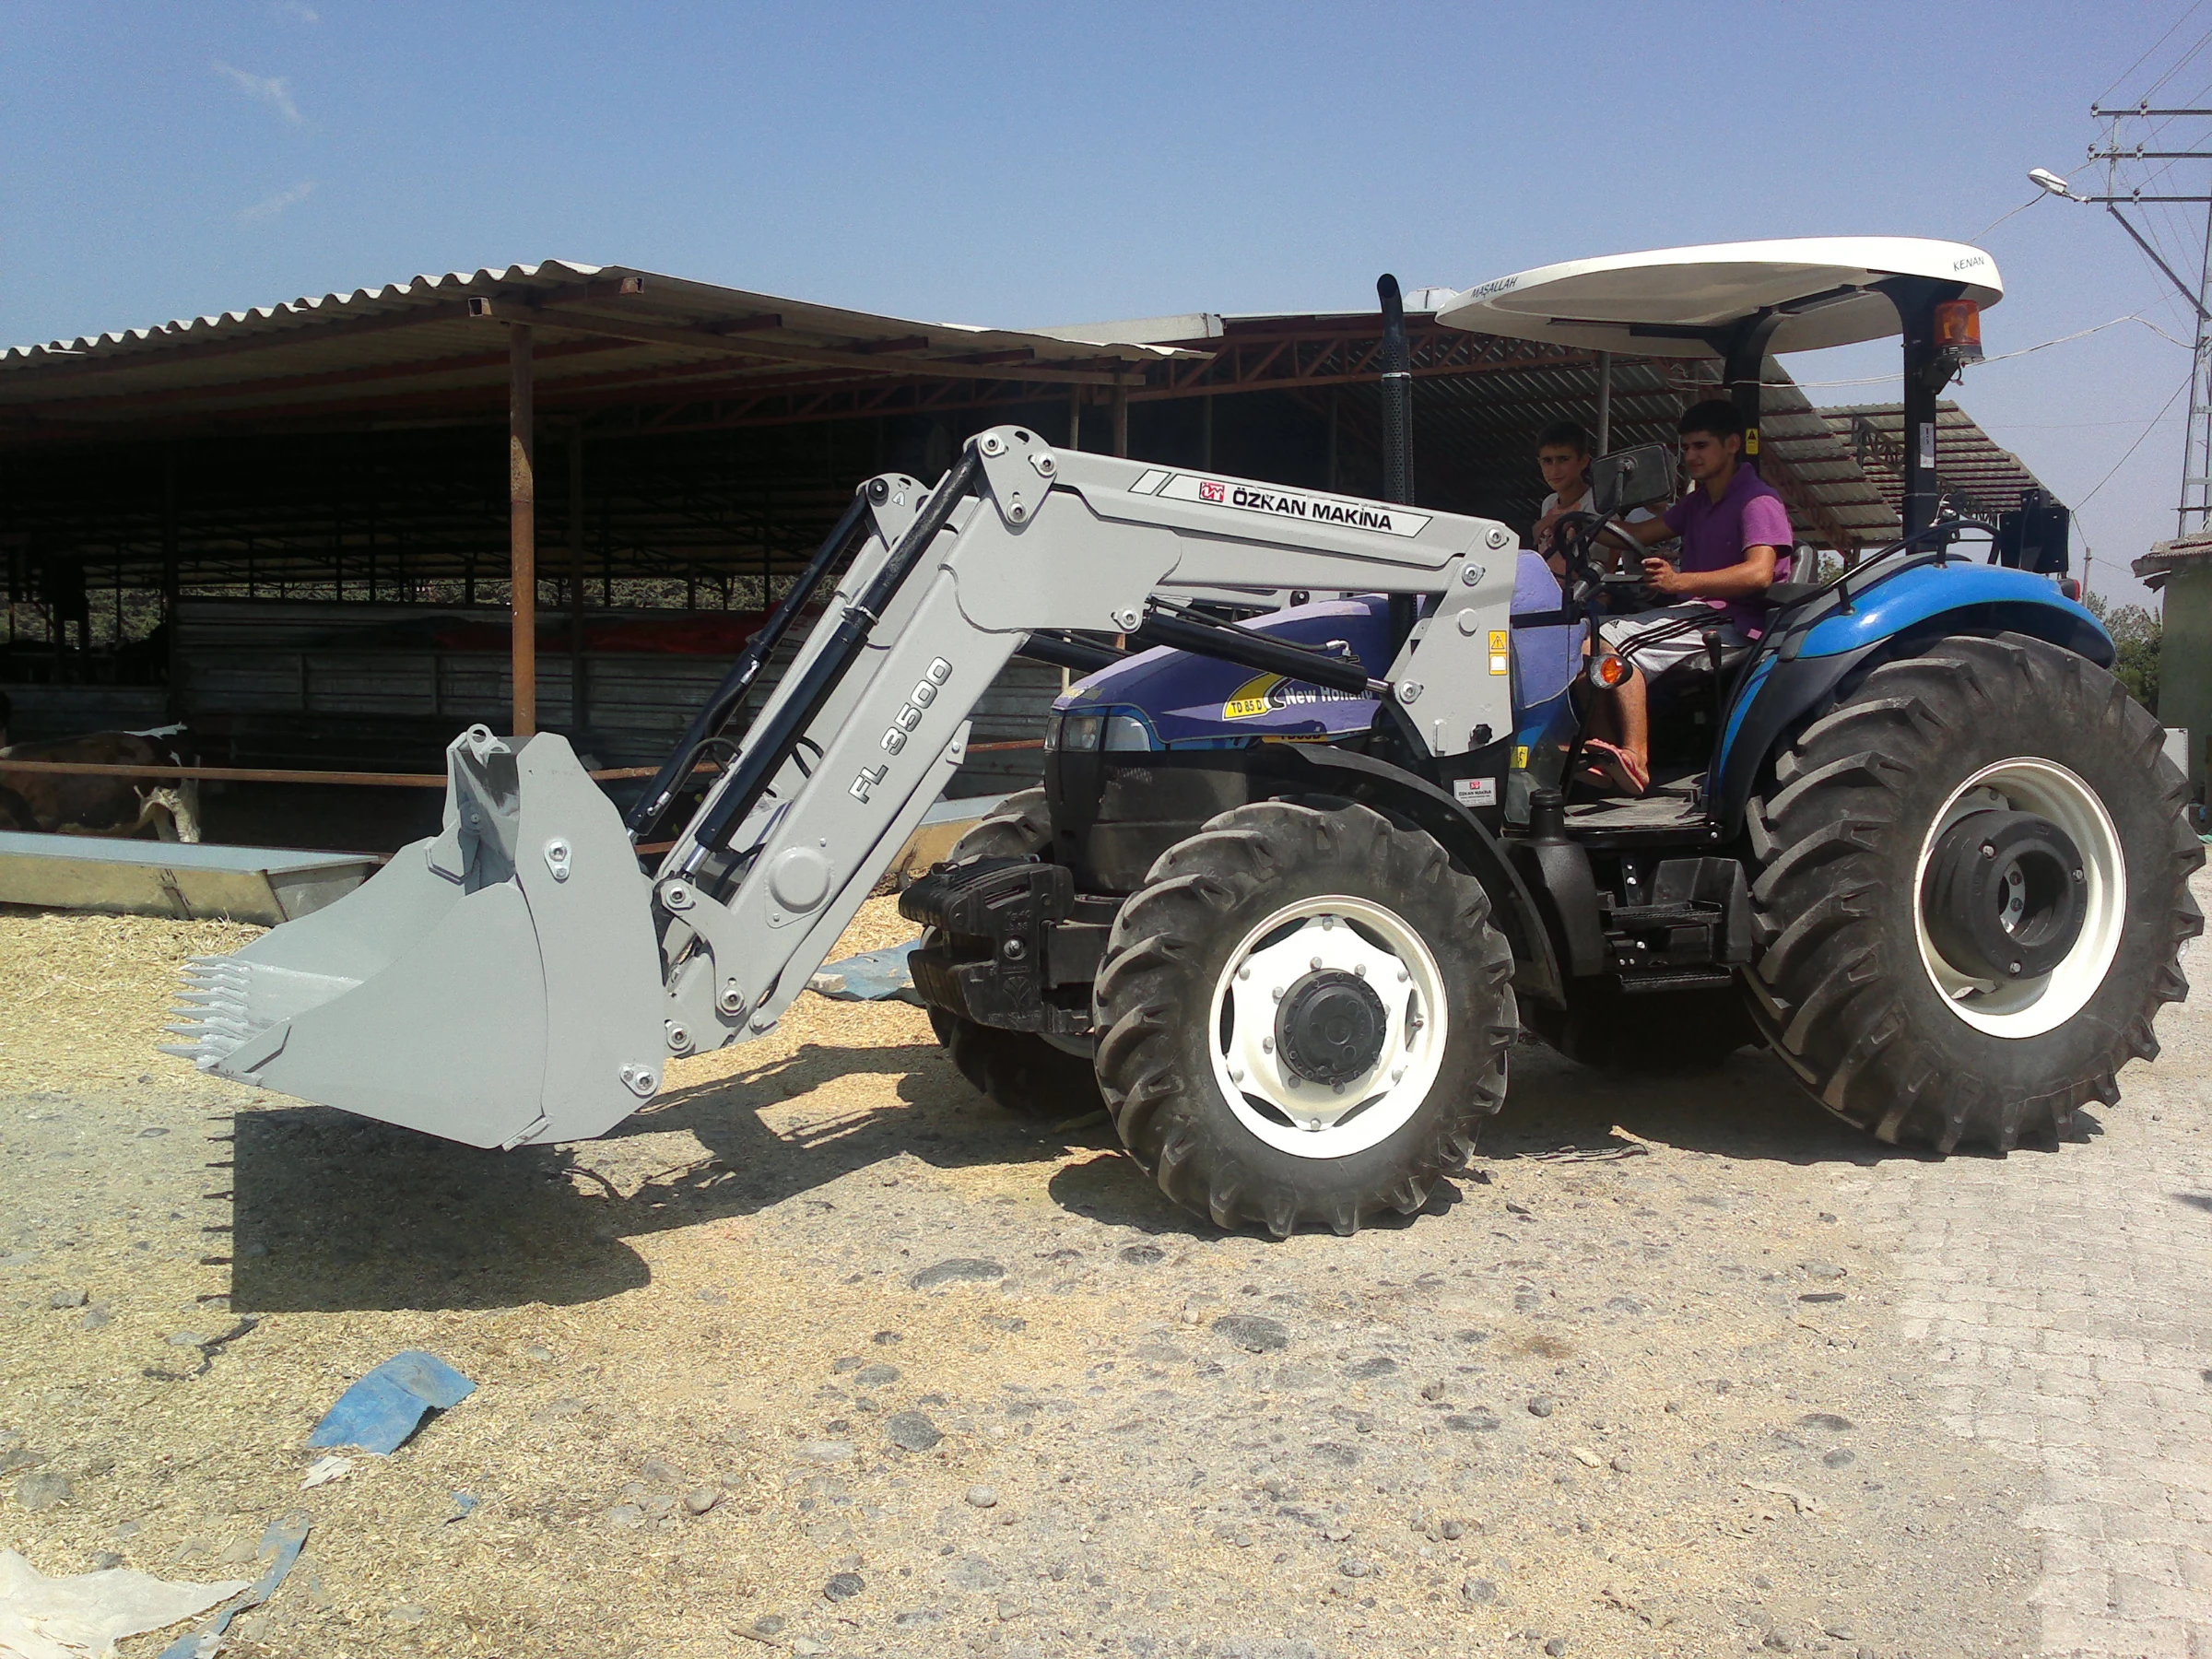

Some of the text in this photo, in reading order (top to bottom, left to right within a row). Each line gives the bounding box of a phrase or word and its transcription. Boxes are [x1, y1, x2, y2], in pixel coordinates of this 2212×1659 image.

[1953, 256, 1985, 272] KENAN
[1470, 276, 1519, 299] MAŞALLAH
[1232, 487, 1393, 531] ÖZKAN MAKİNA
[1284, 687, 1316, 704] New
[1231, 700, 1263, 713] TD 85 D
[848, 656, 952, 804] FL 3500
